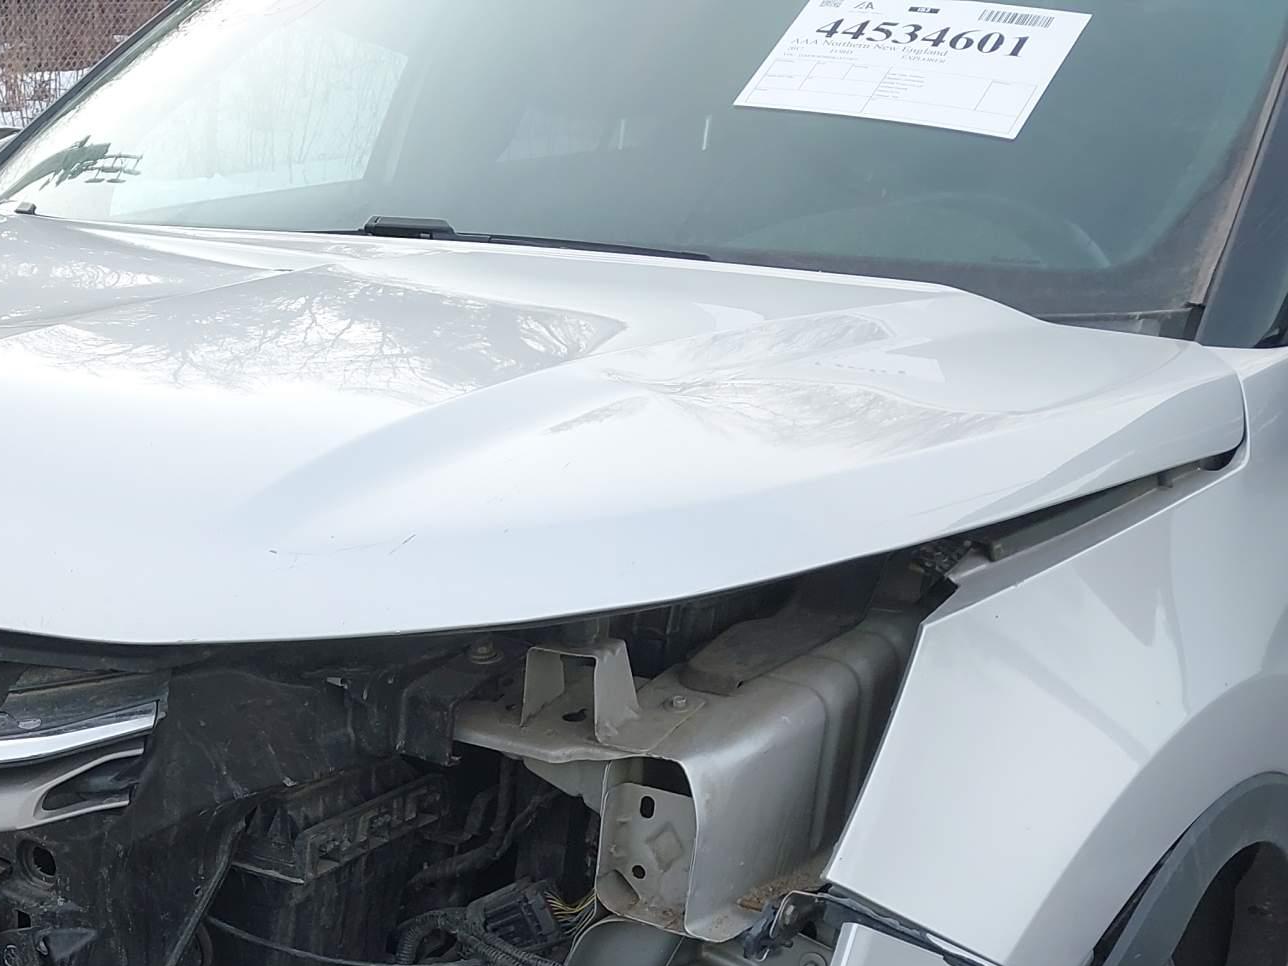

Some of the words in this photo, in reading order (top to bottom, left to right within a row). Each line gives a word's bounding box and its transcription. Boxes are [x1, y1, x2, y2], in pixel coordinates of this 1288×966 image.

[816, 18, 1030, 58] 44534601
[823, 39, 870, 49] Northern
[873, 43, 896, 51] New
[901, 46, 948, 57] England
